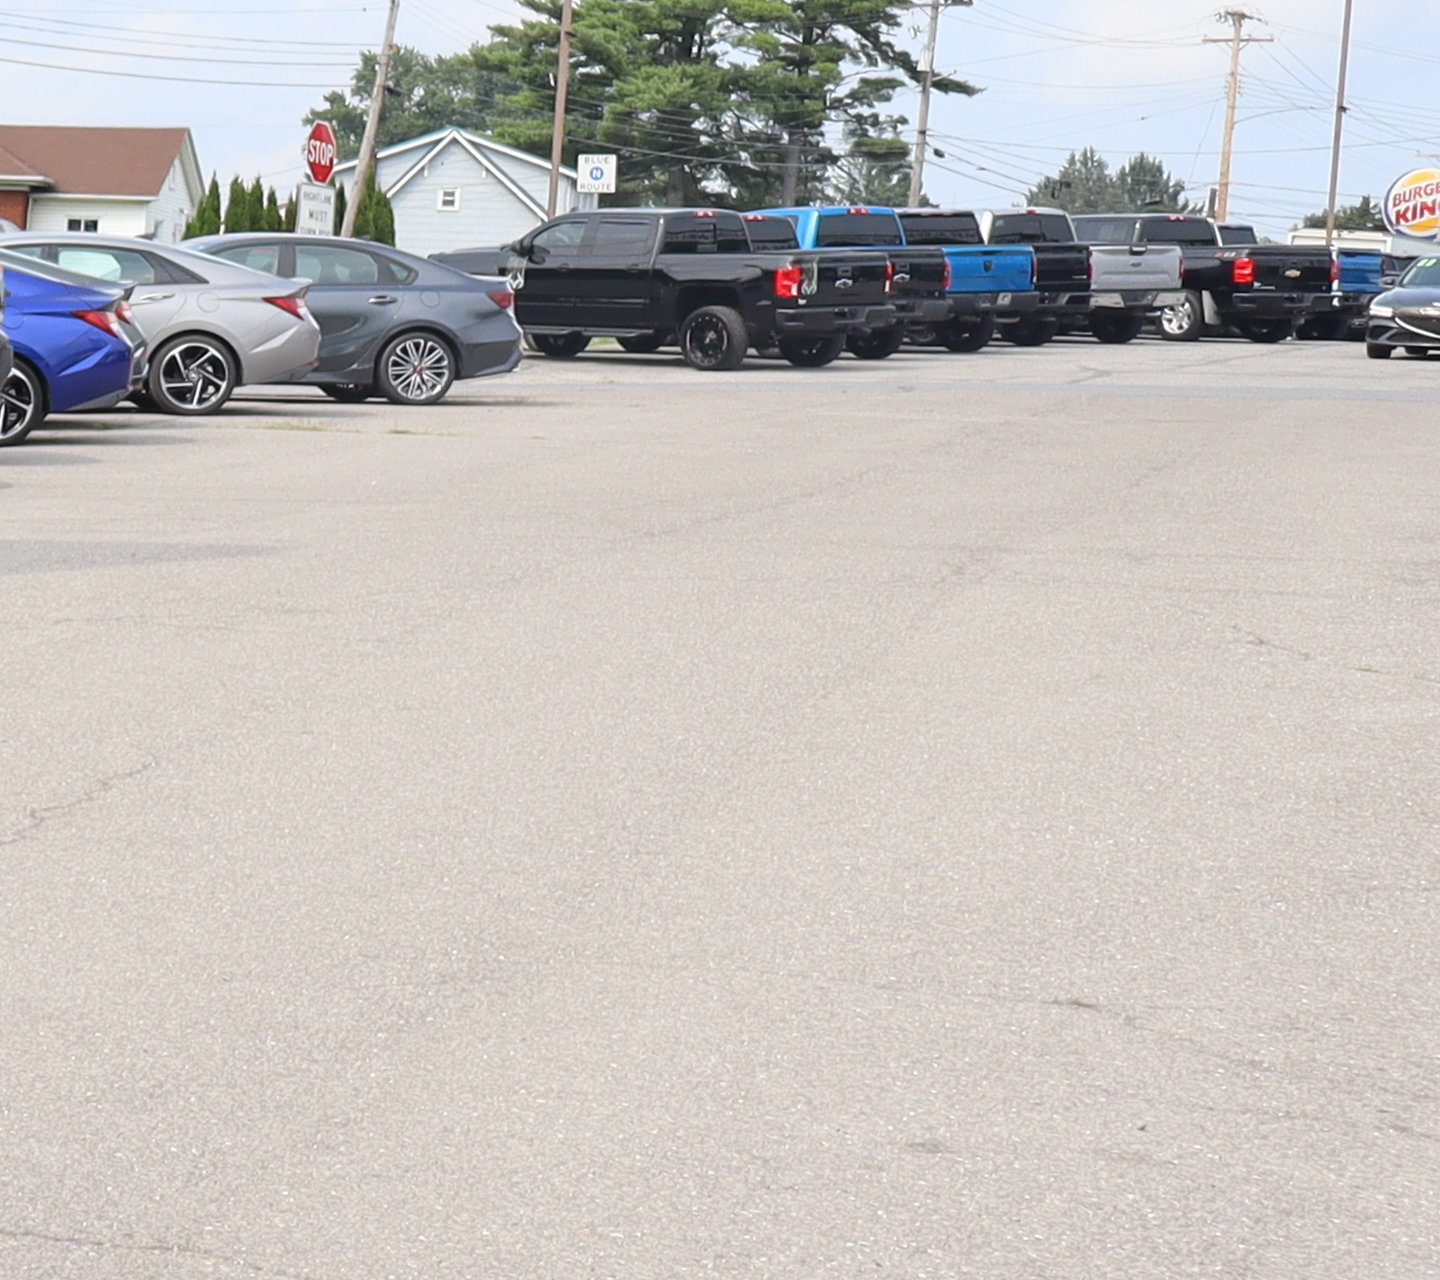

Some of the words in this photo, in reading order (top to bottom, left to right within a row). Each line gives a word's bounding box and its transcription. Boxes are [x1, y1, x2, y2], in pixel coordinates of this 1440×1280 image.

[308, 138, 334, 166] STOP
[584, 156, 610, 164] BLUE
[580, 183, 612, 191] ROUTE
[1395, 198, 1440, 226] KIN
